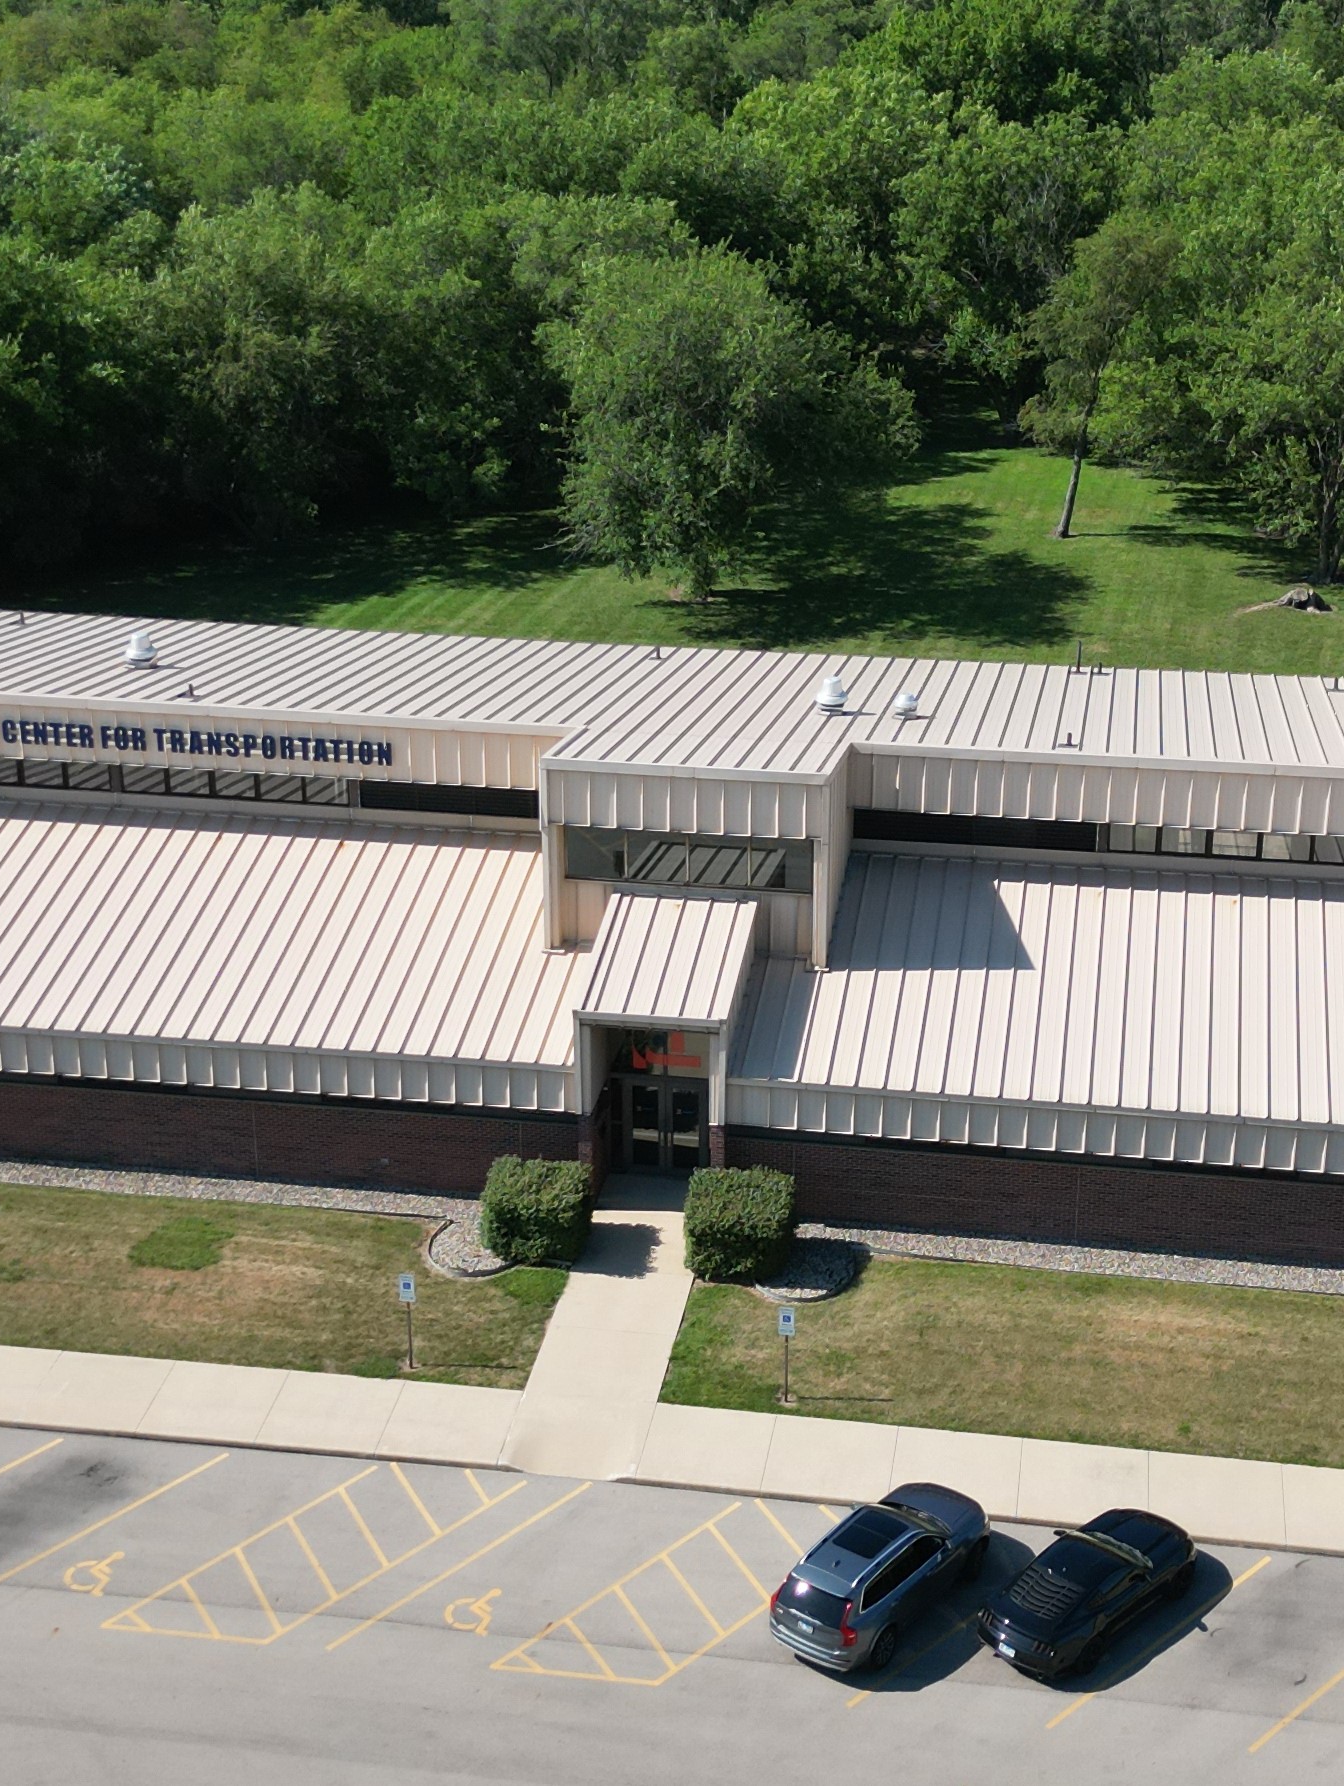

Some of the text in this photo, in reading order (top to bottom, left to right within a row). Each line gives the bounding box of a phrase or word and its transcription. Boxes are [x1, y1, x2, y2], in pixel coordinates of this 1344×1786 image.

[2, 719, 94, 749] CENTER
[100, 725, 147, 752] FOR
[153, 728, 393, 766] TRANSPORTATION
